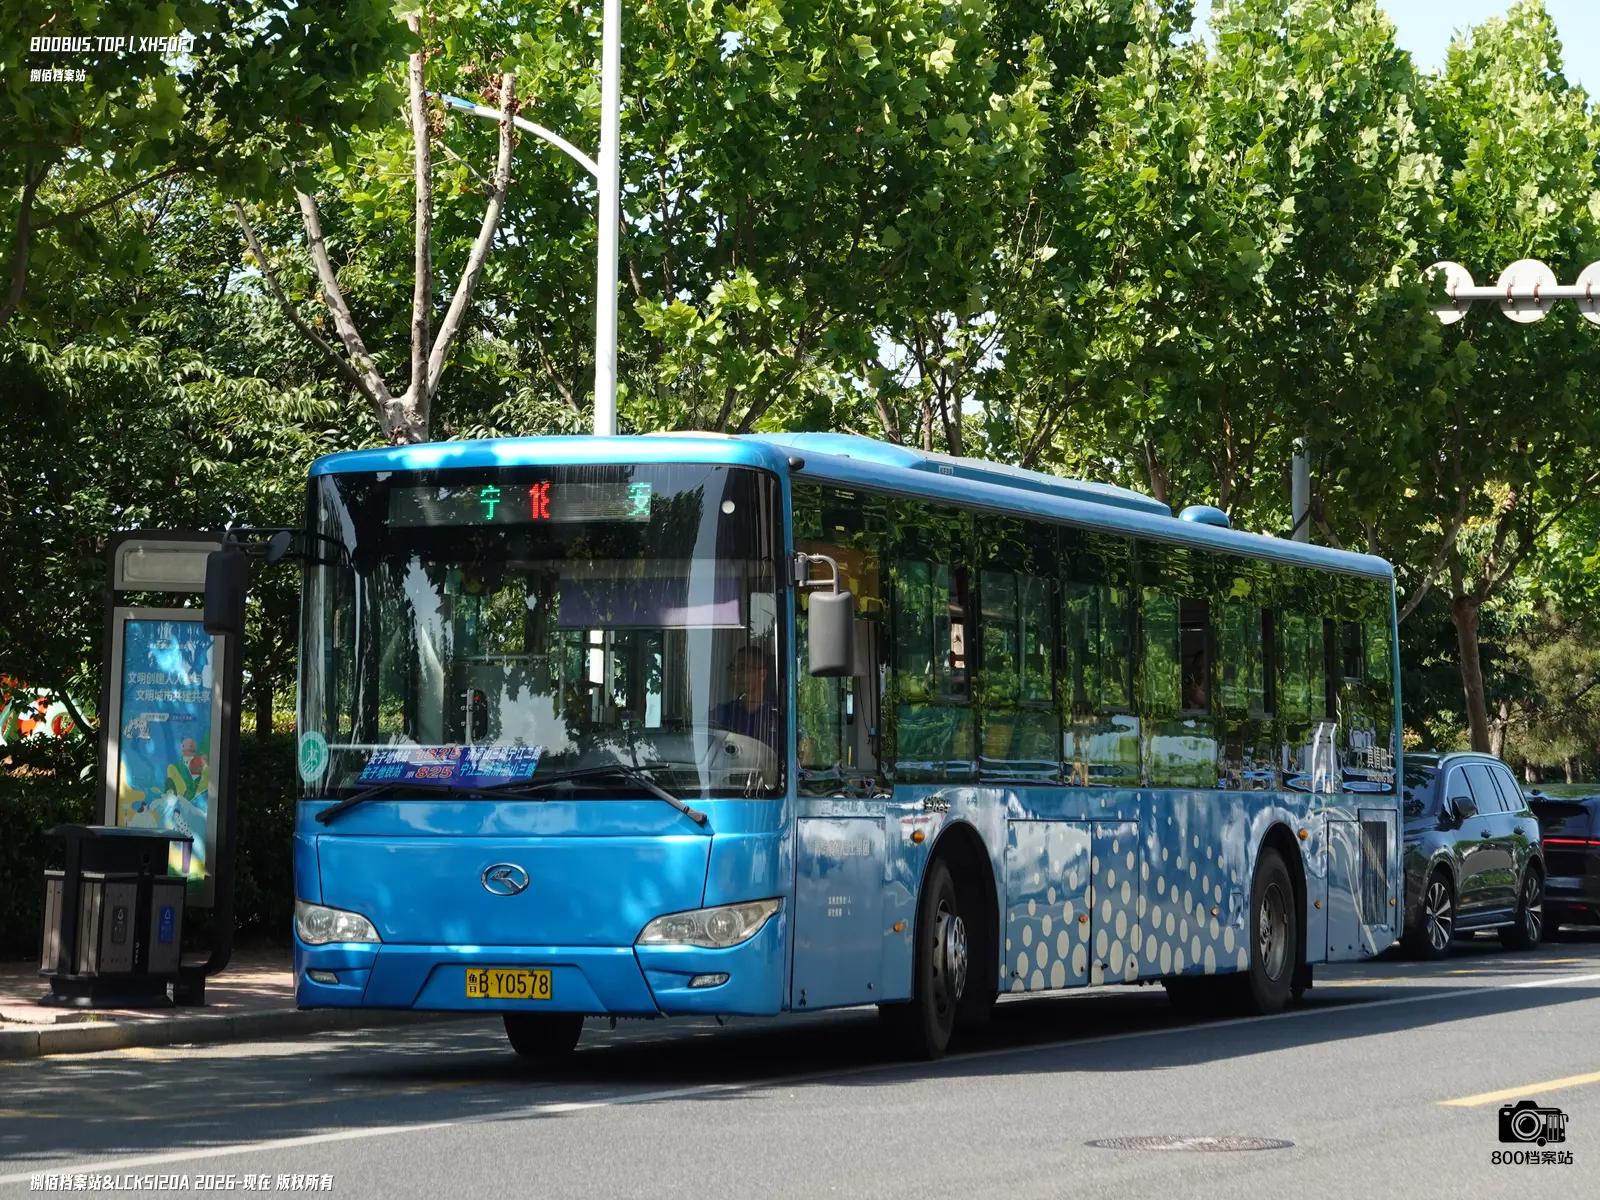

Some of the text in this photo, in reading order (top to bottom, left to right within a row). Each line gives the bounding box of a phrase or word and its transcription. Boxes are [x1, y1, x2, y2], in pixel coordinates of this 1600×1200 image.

[128, 671, 202, 686] 文明创建人人与
[135, 689, 211, 702] 文明城市共建共享
[415, 747, 463, 760] 1825
